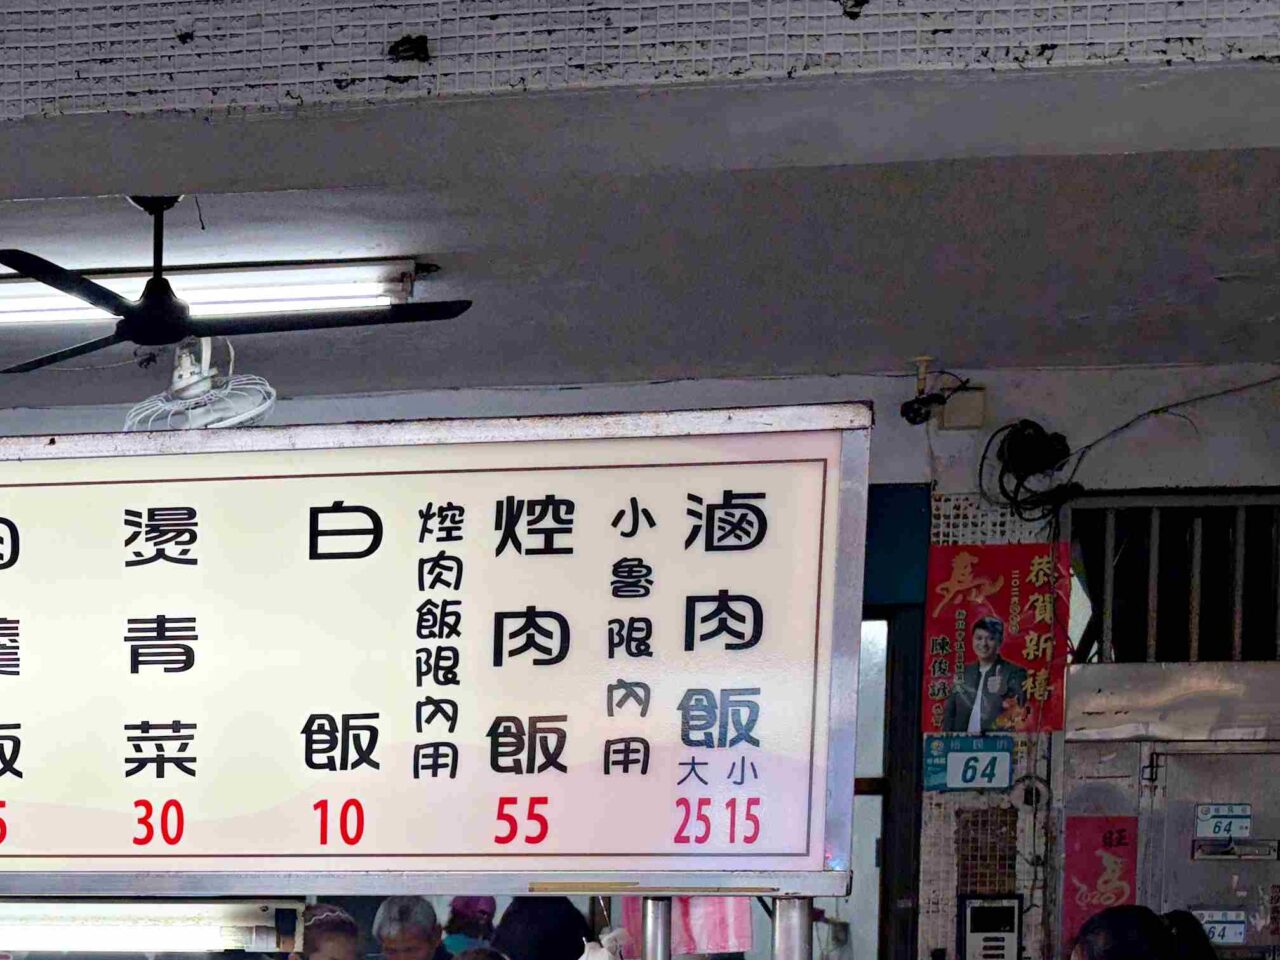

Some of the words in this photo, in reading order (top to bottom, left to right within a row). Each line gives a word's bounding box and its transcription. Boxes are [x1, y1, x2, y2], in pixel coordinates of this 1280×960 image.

[124, 507, 200, 780] 燙青菜
[301, 501, 385, 773] 白飯
[604, 497, 658, 777] 小魯限內用
[677, 490, 769, 750] 滷肉飯
[1022, 554, 1059, 700] 恭賀新禧
[677, 756, 709, 785] 大
[726, 755, 759, 785] 小
[961, 755, 998, 784] 64
[133, 800, 186, 847] 30
[314, 799, 366, 847] 10
[495, 797, 550, 846] 55
[674, 798, 712, 844] 25
[725, 798, 761, 844] 15
[1211, 819, 1233, 835] 64
[1207, 925, 1227, 940] 64
